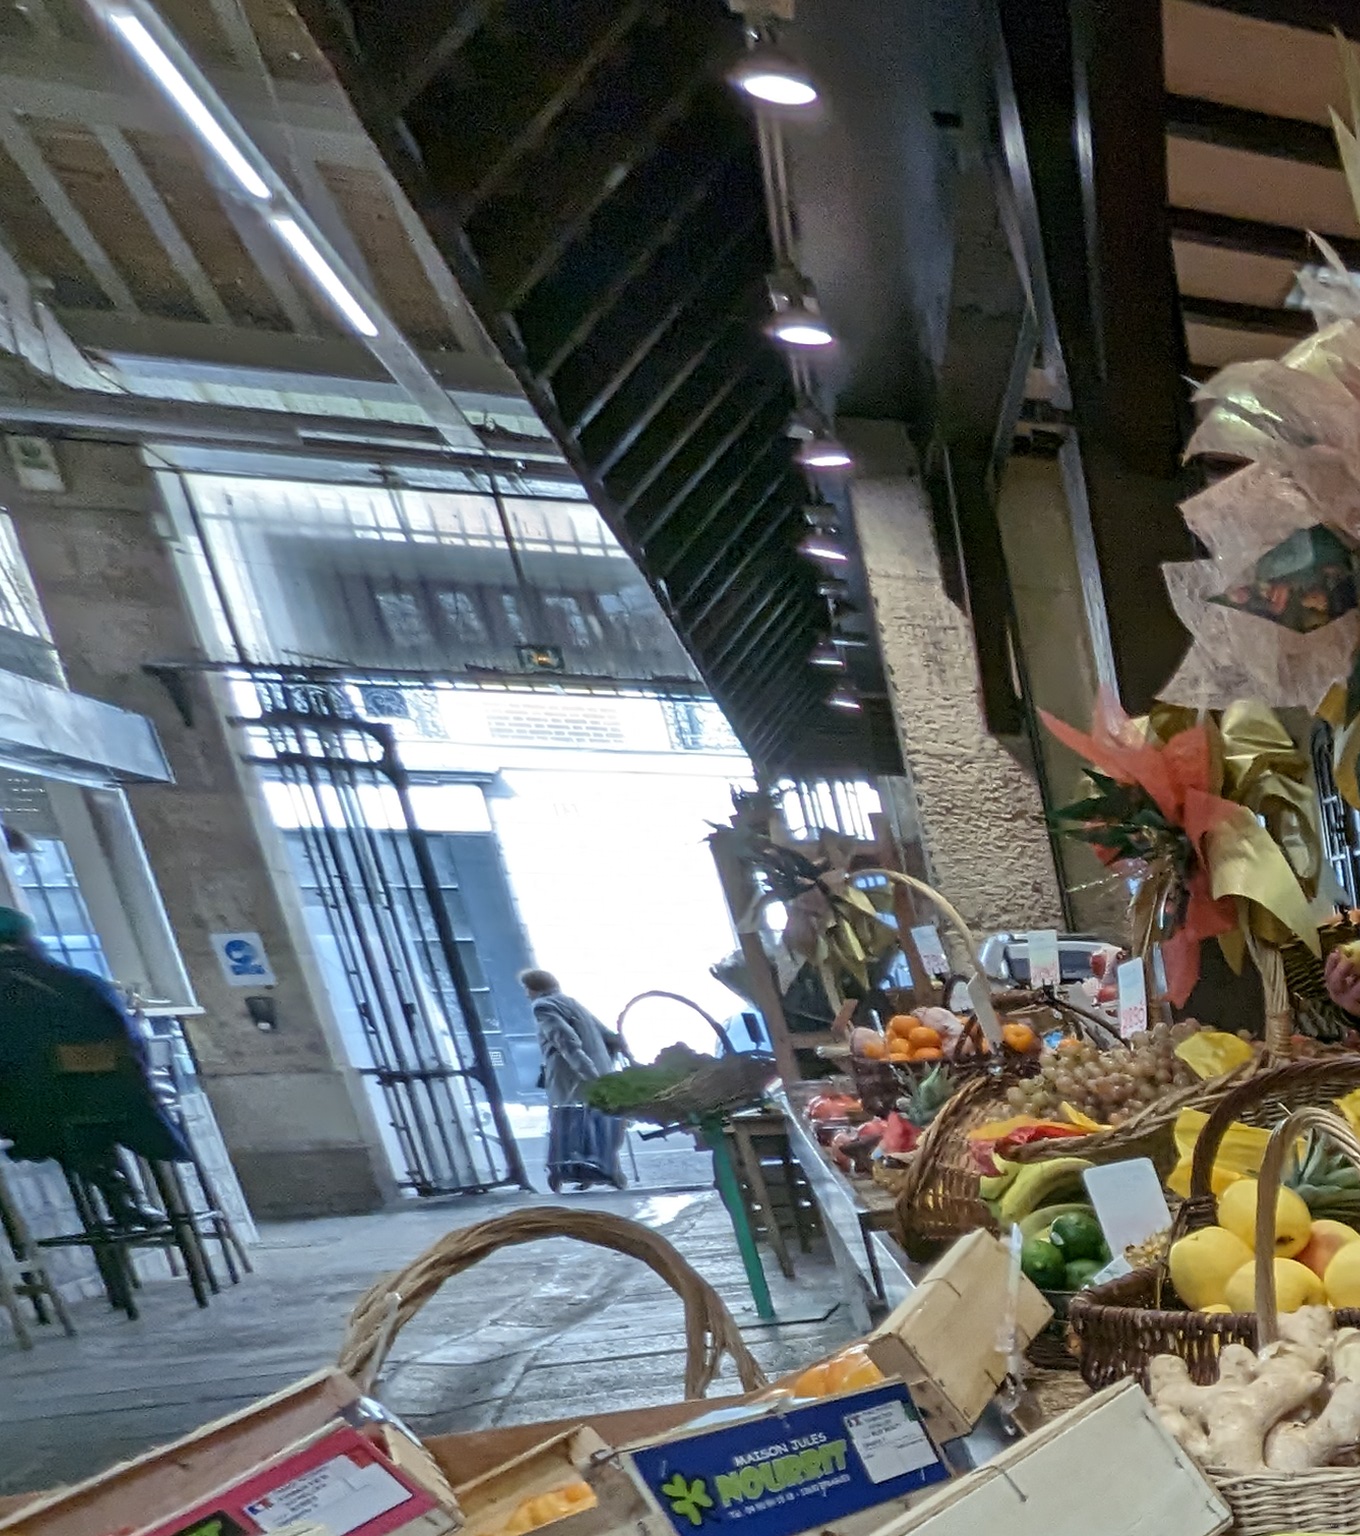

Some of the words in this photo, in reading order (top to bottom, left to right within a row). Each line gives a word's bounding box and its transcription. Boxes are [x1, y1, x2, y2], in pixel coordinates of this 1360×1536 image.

[714, 1438, 848, 1508] NOURRIT
[734, 1442, 789, 1468] MAISON
[790, 1431, 828, 1454] JULES
